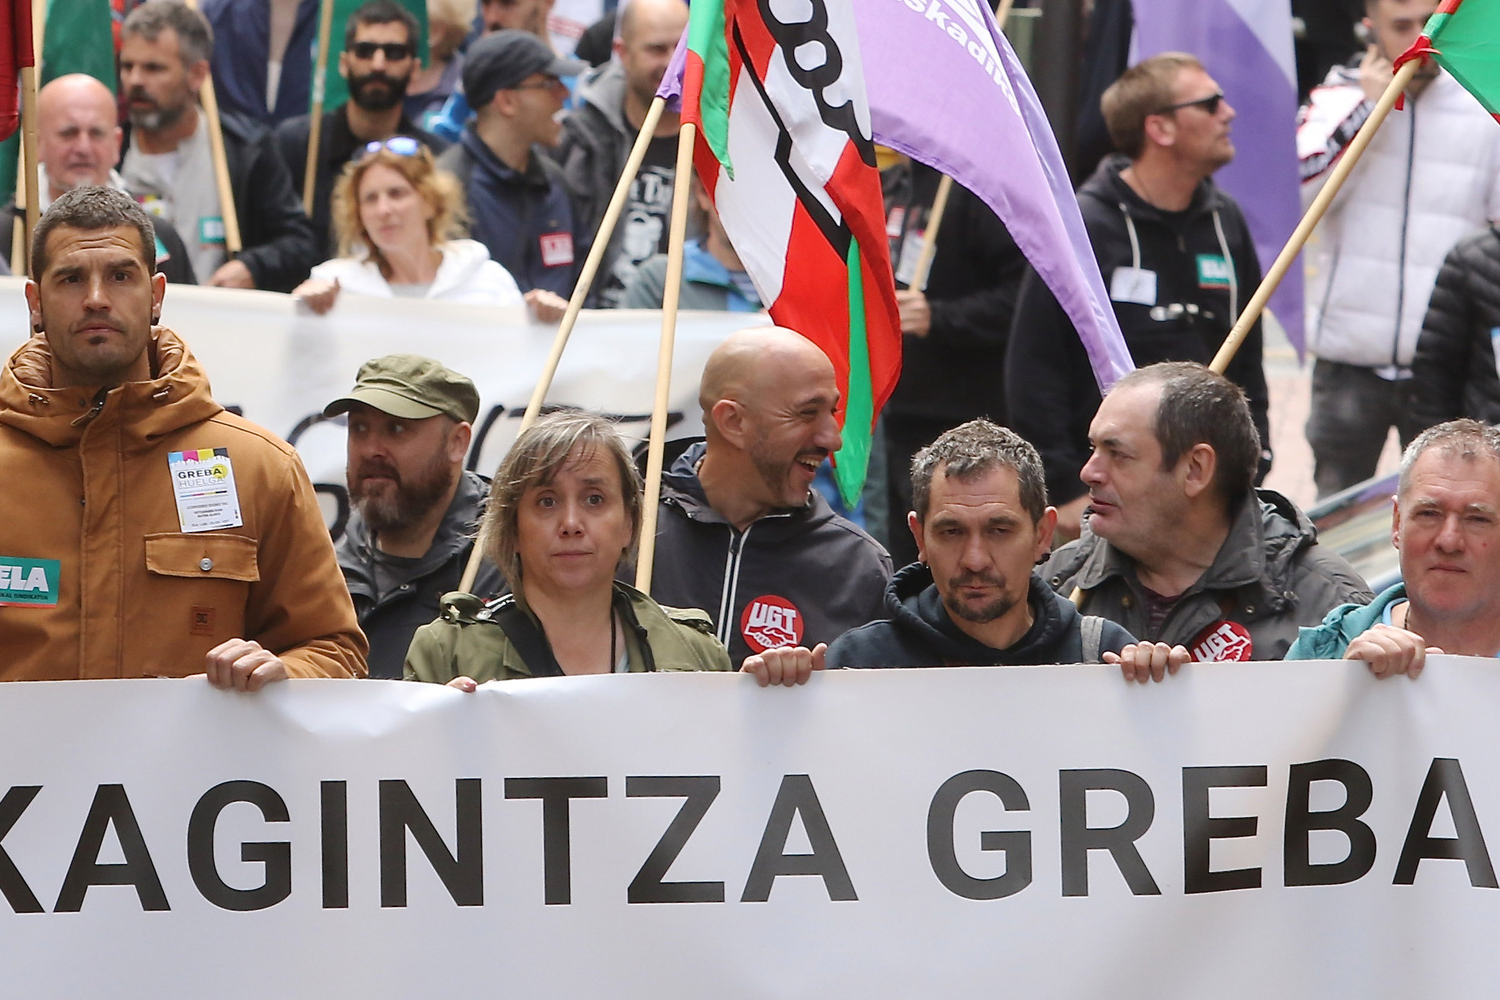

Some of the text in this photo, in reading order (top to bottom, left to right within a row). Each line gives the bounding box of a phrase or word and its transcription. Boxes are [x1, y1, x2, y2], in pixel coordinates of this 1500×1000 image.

[178, 468, 222, 479] GREBA
[180, 477, 224, 487] HUELGA
[750, 602, 797, 632] UGT
[1195, 622, 1236, 660] UGT
[926, 757, 1499, 901] GREBA
